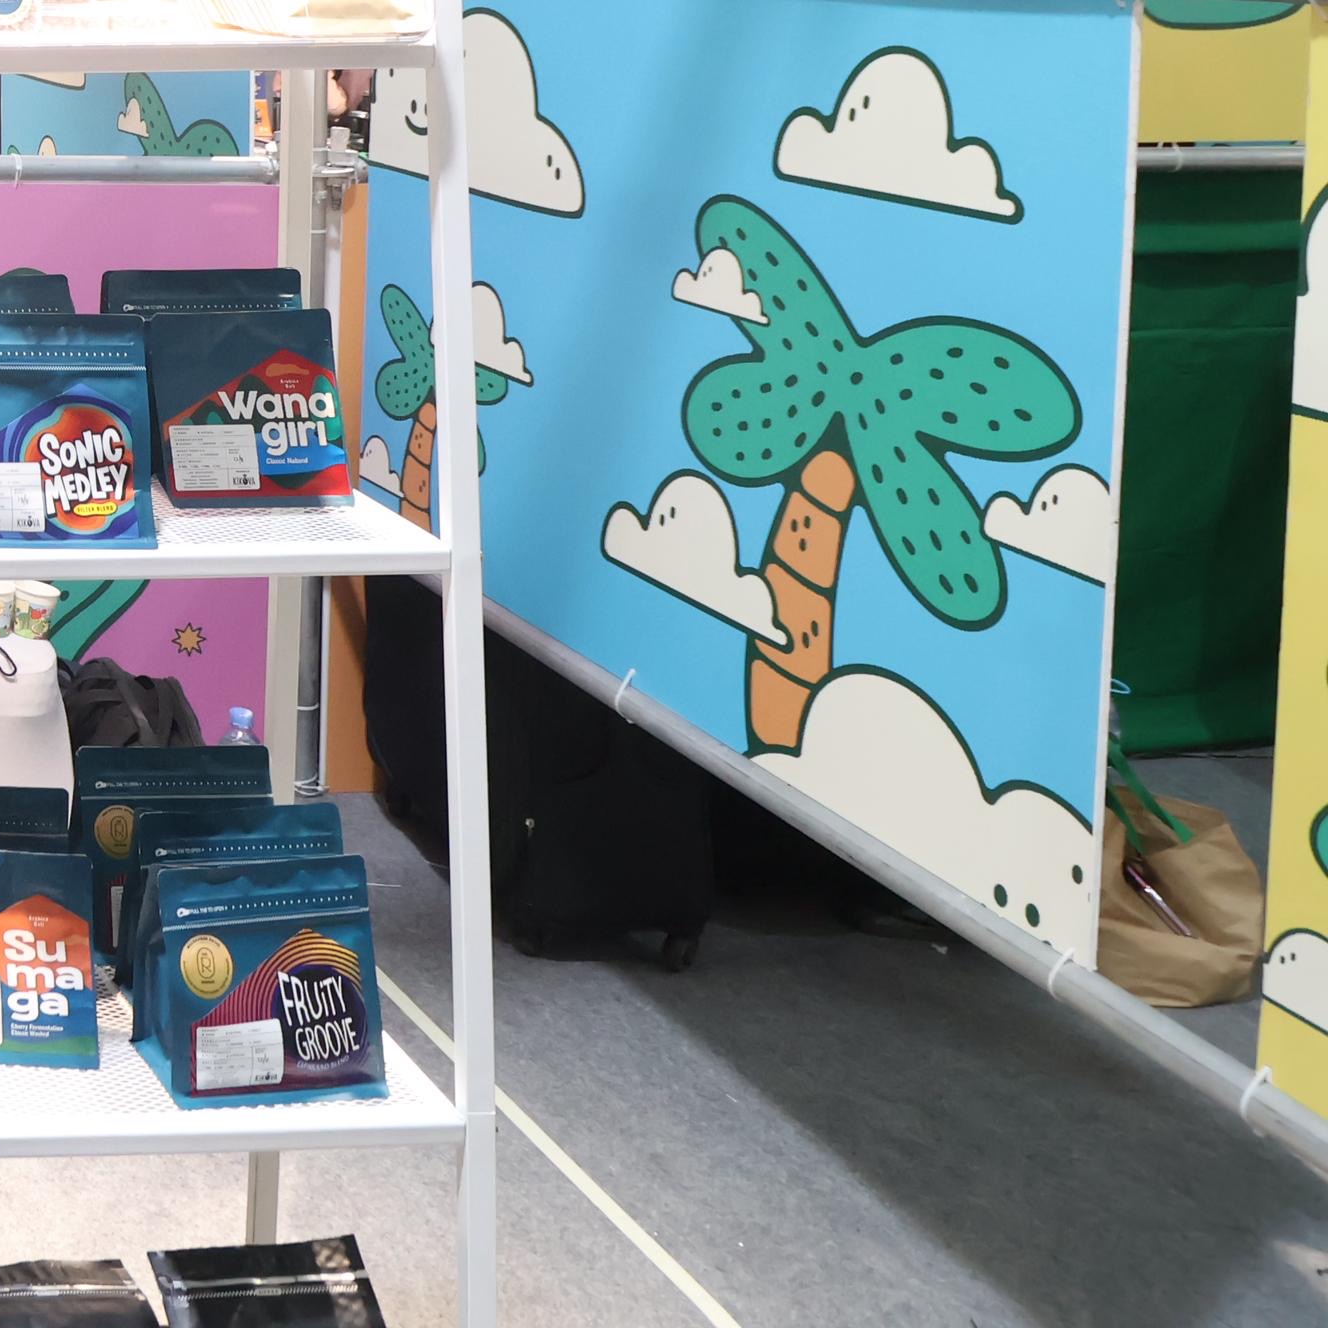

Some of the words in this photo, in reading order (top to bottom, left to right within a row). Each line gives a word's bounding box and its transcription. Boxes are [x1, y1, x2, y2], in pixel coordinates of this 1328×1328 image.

[217, 390, 336, 421] Wana
[38, 426, 124, 476] SONIC
[261, 420, 328, 457] giri
[43, 464, 128, 516] MEDLEY
[76, 504, 94, 514] FILTER
[96, 503, 114, 513] BLEND
[2, 928, 67, 963] Su
[6, 963, 84, 991] ma
[7, 990, 69, 1022] ga
[295, 1017, 360, 1061] GROOVE
